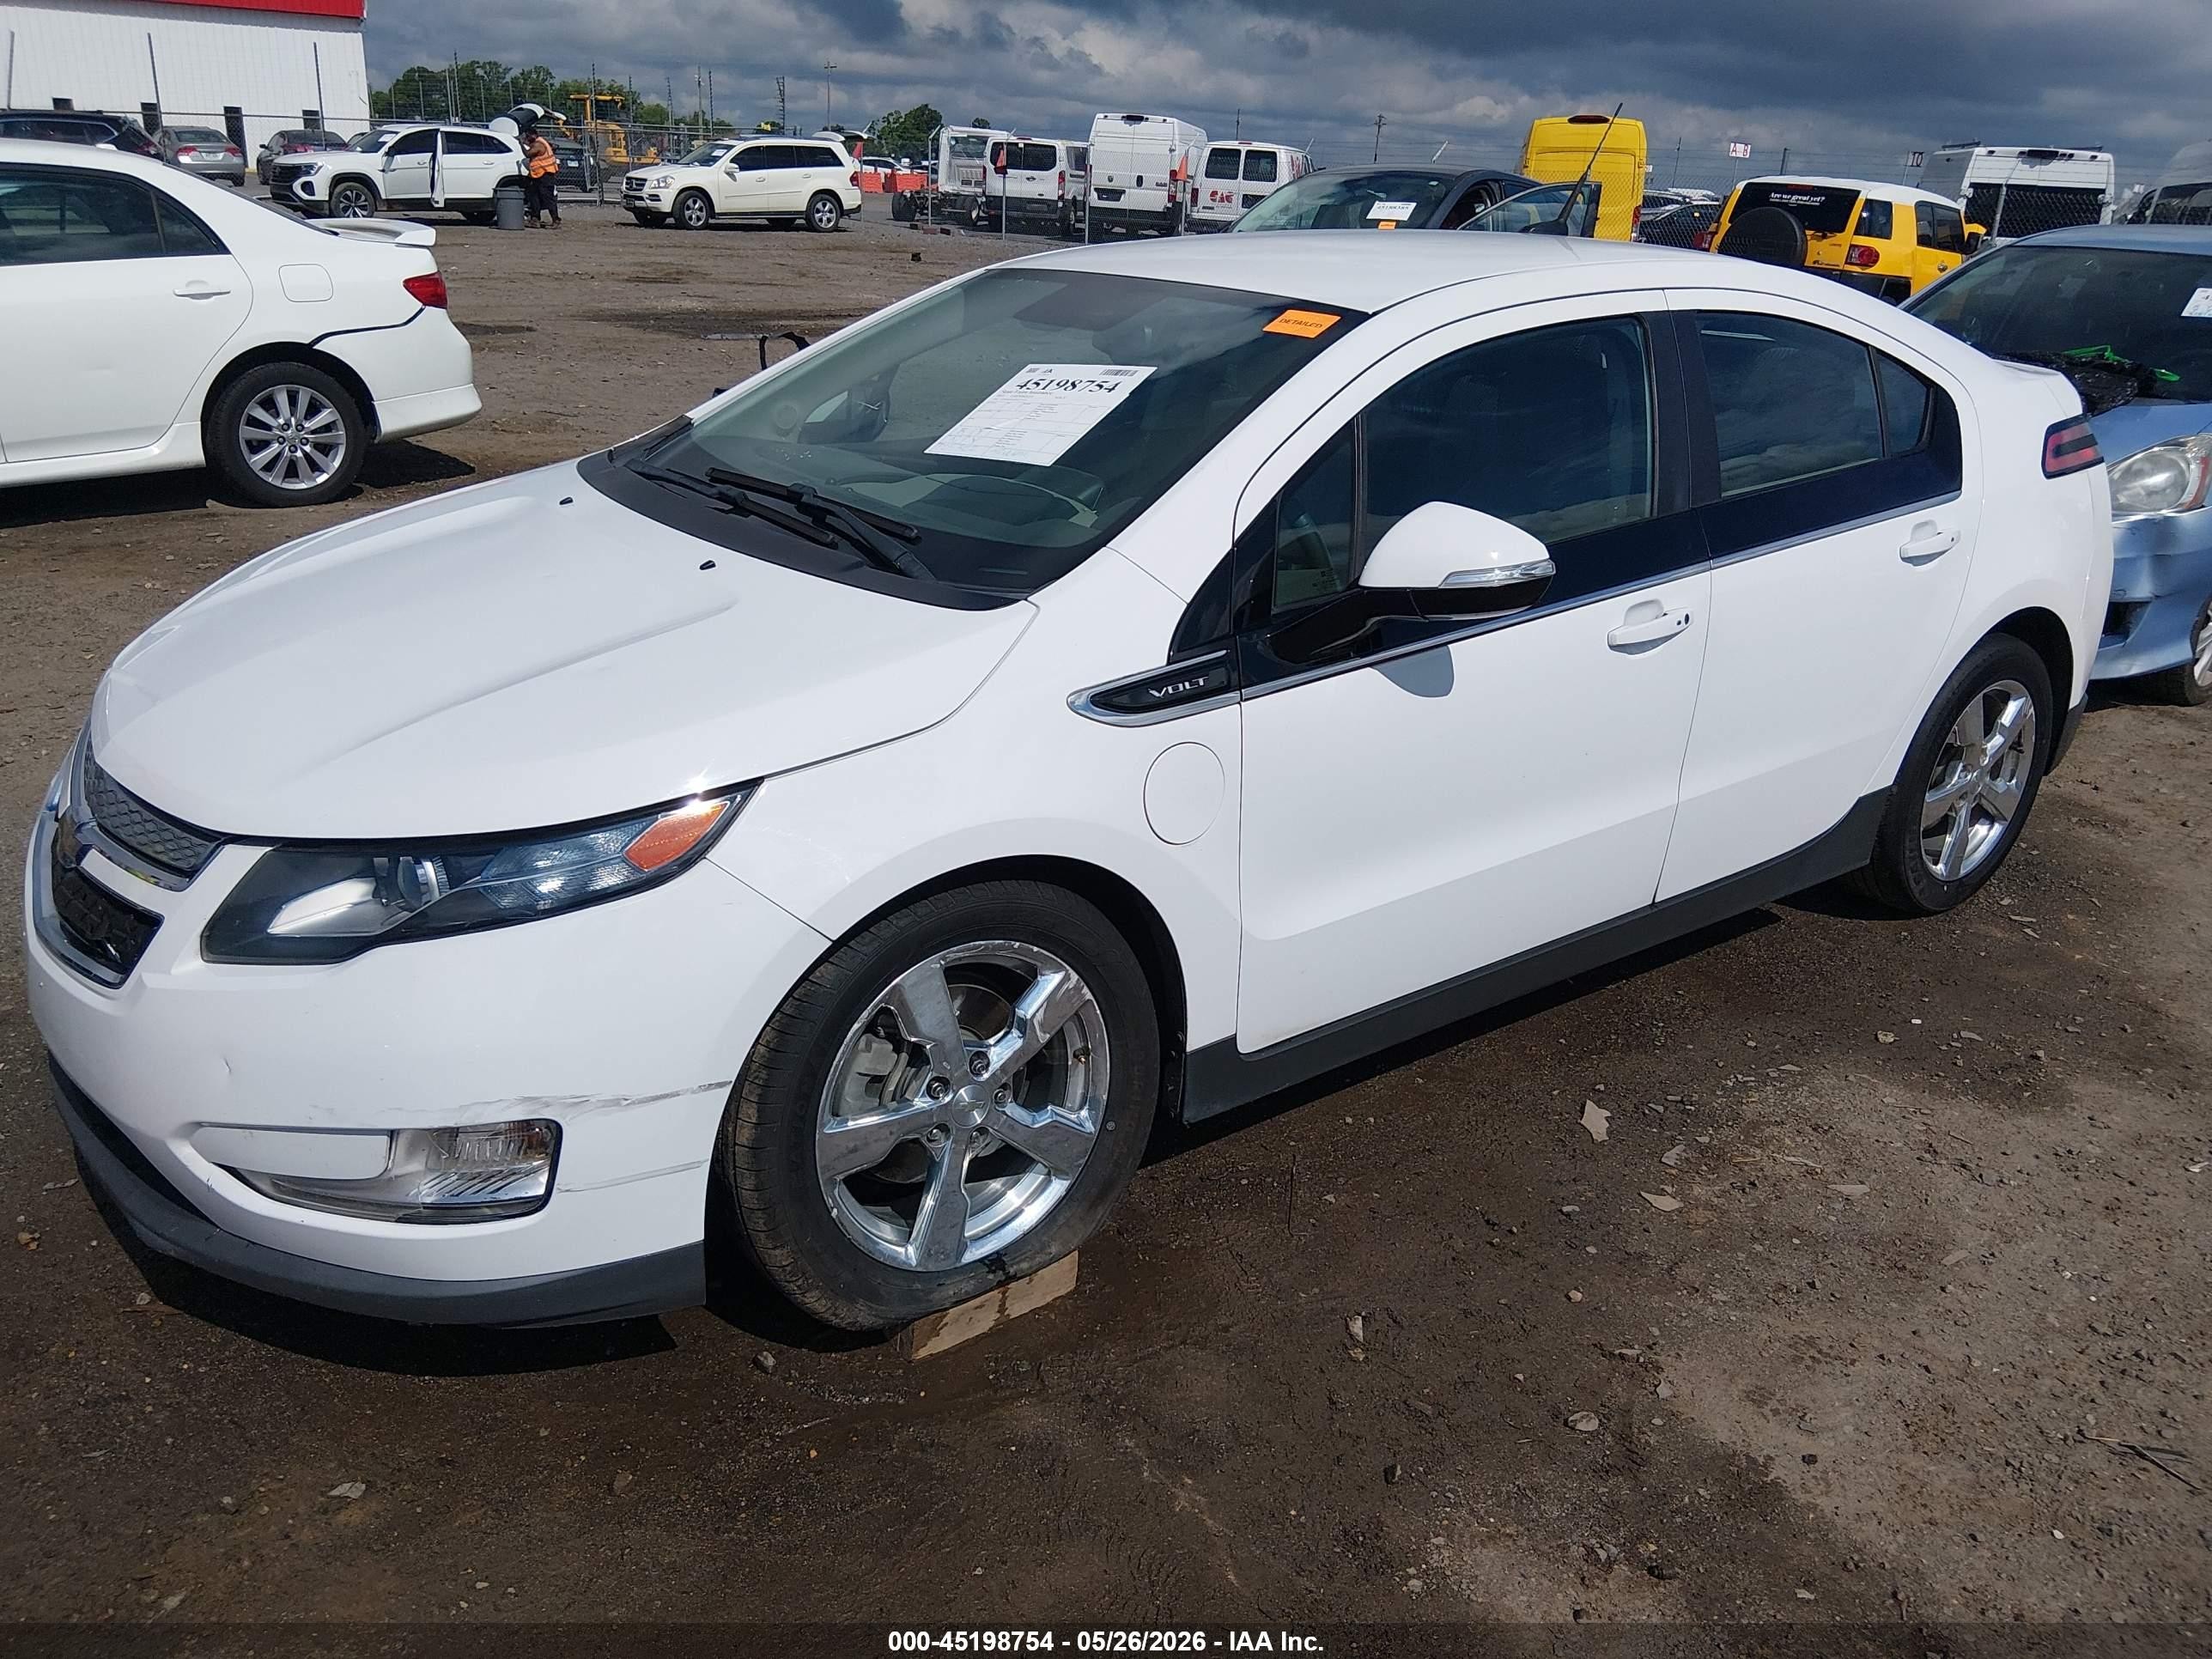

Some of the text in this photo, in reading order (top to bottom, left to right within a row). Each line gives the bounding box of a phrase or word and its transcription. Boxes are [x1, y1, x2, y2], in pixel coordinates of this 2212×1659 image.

[1279, 318, 1323, 329] DETAILED
[1016, 378, 1123, 393] 45198754
[1147, 676, 1210, 699] VOLT
